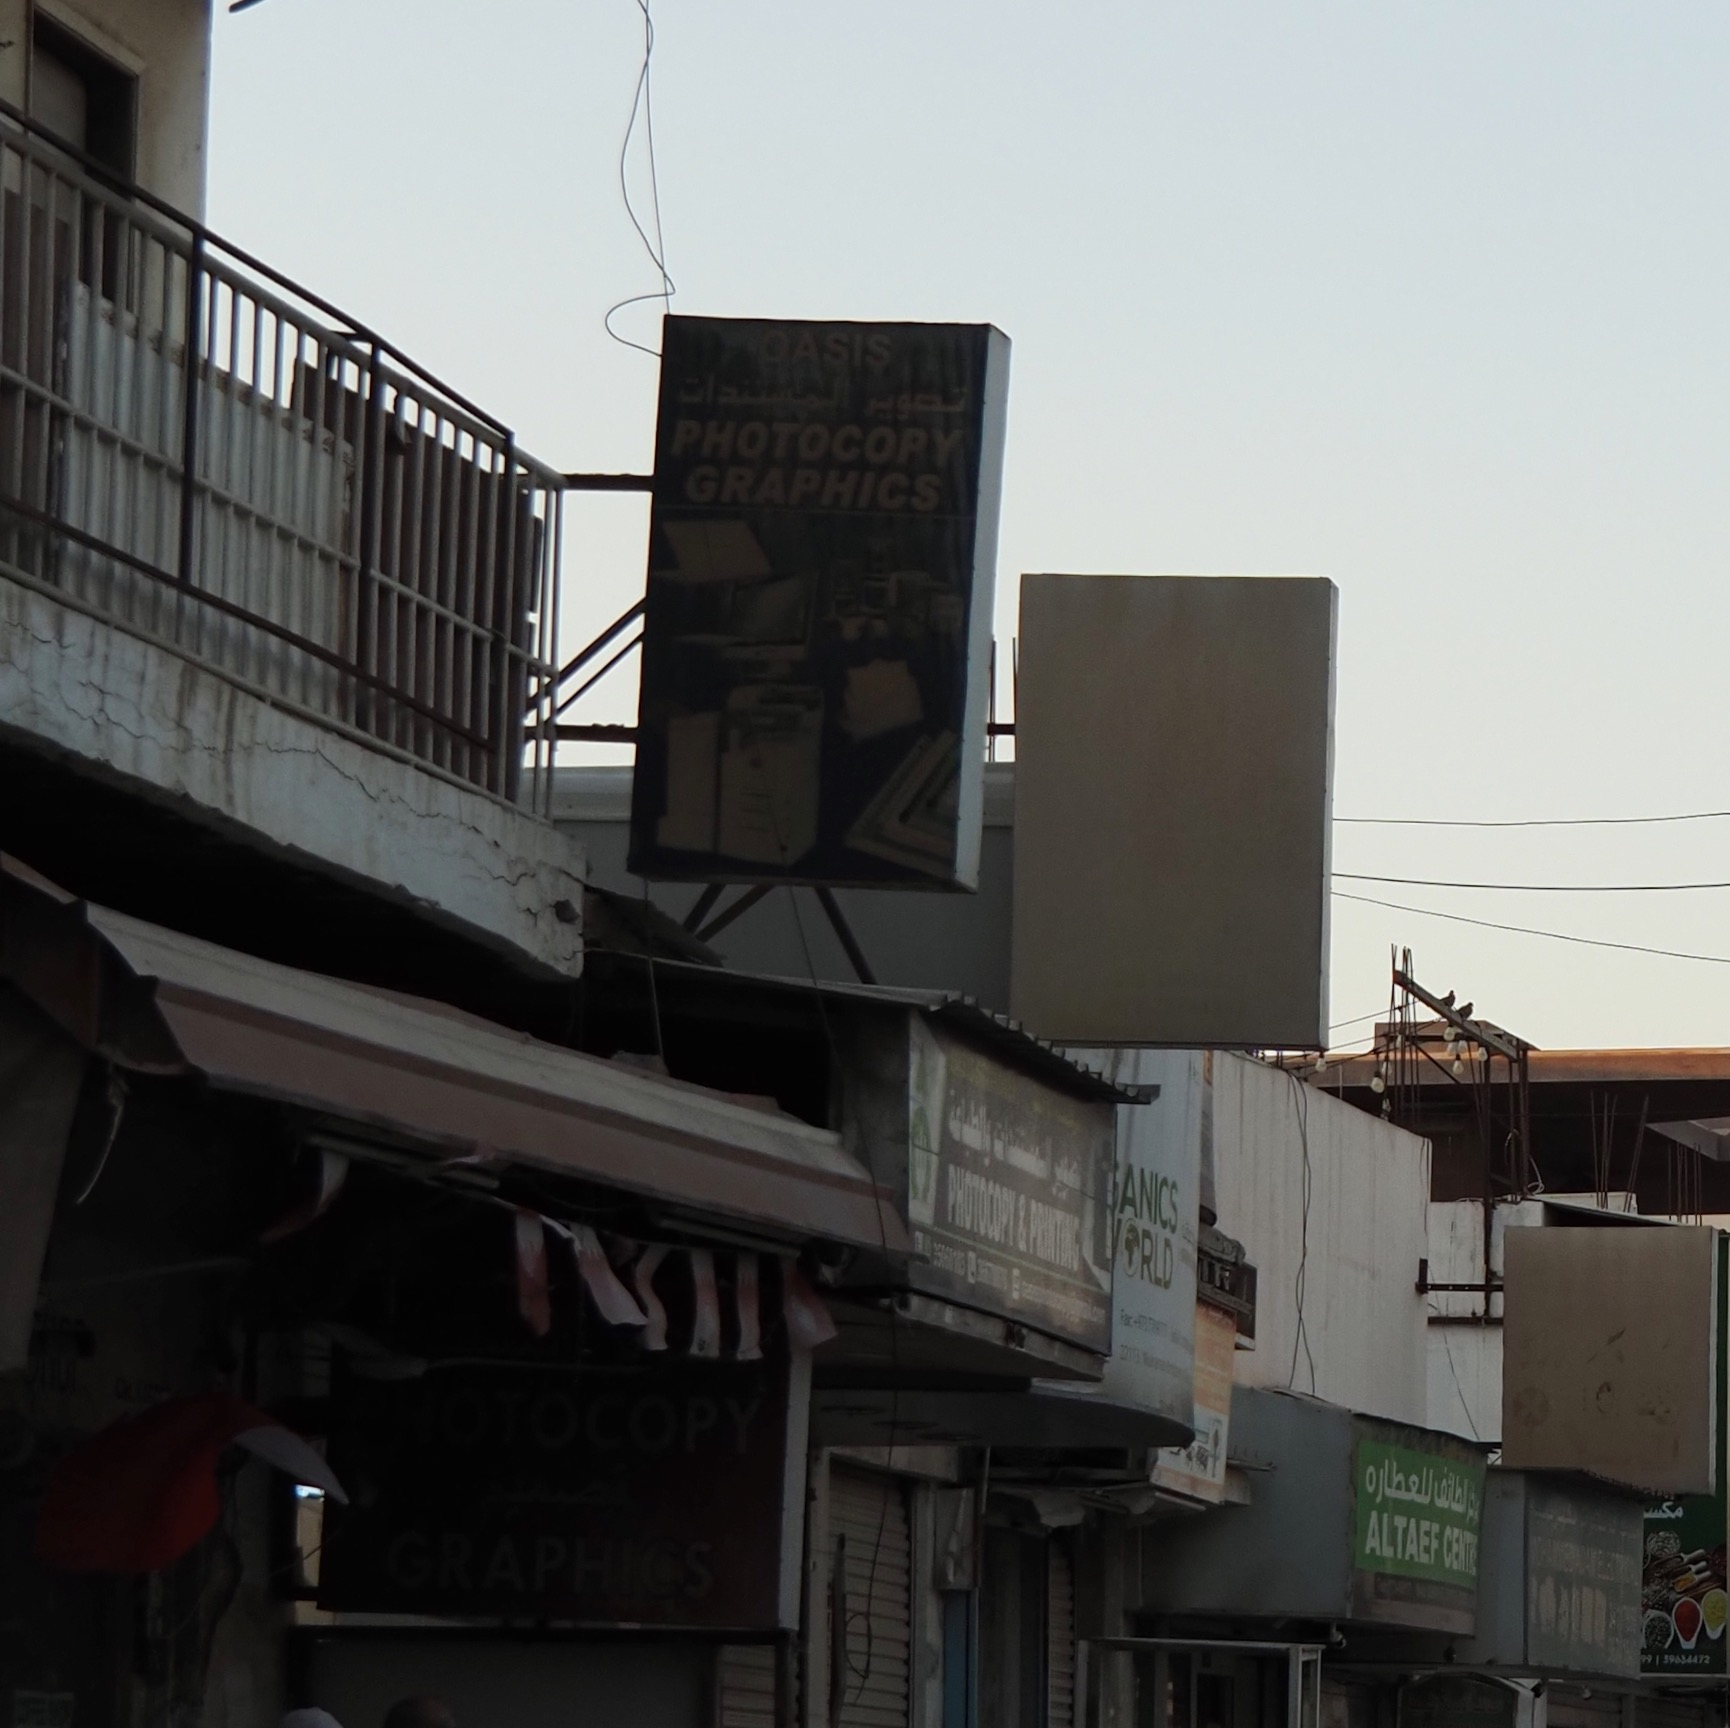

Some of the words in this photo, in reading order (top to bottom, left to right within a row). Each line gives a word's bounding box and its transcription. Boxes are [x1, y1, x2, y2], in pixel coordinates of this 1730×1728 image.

[759, 328, 893, 369] OASIS
[864, 384, 968, 421] تصوير
[669, 419, 964, 468] PHOTOCOPY
[684, 464, 945, 512] GRAPHICS
[948, 1163, 1017, 1248] PHOTOCOPY
[1018, 1193, 1027, 1253] &
[352, 1387, 764, 1456] PHOTOCOPY
[1365, 1458, 1434, 1504] للعطاره
[1364, 1510, 1440, 1565] ALTAEF
[386, 1529, 716, 1600] GRAPHICS
